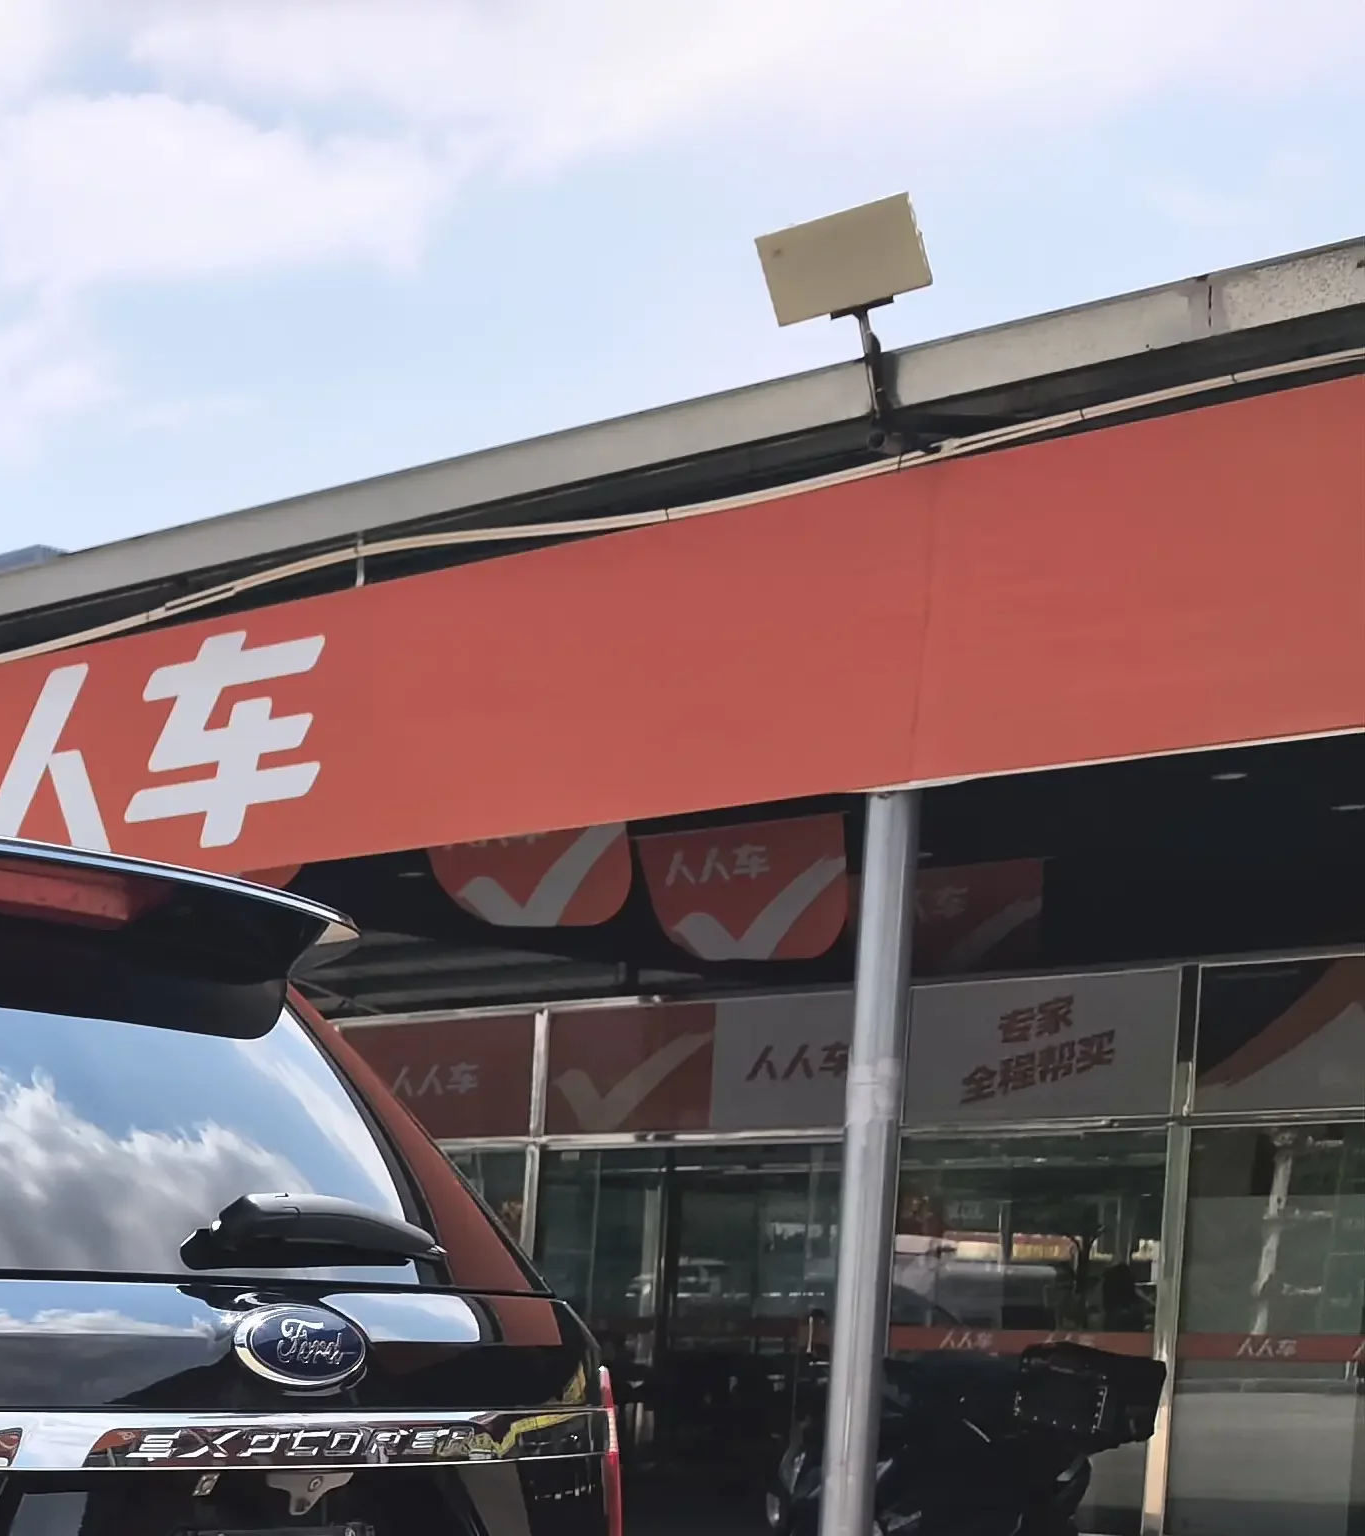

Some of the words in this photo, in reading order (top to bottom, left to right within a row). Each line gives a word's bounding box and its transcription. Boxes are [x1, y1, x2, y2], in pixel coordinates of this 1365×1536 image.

[665, 843, 771, 886] 人人车
[997, 995, 1075, 1045] 专家
[392, 1062, 478, 1096] 人人车
[745, 1043, 849, 1082] 人人车
[960, 1029, 1116, 1105] 全程帮买
[277, 1318, 356, 1365] Ford
[940, 1331, 992, 1349] 人人车
[1236, 1336, 1297, 1357] 人人车
[125, 1427, 477, 1461] EXPLORER
